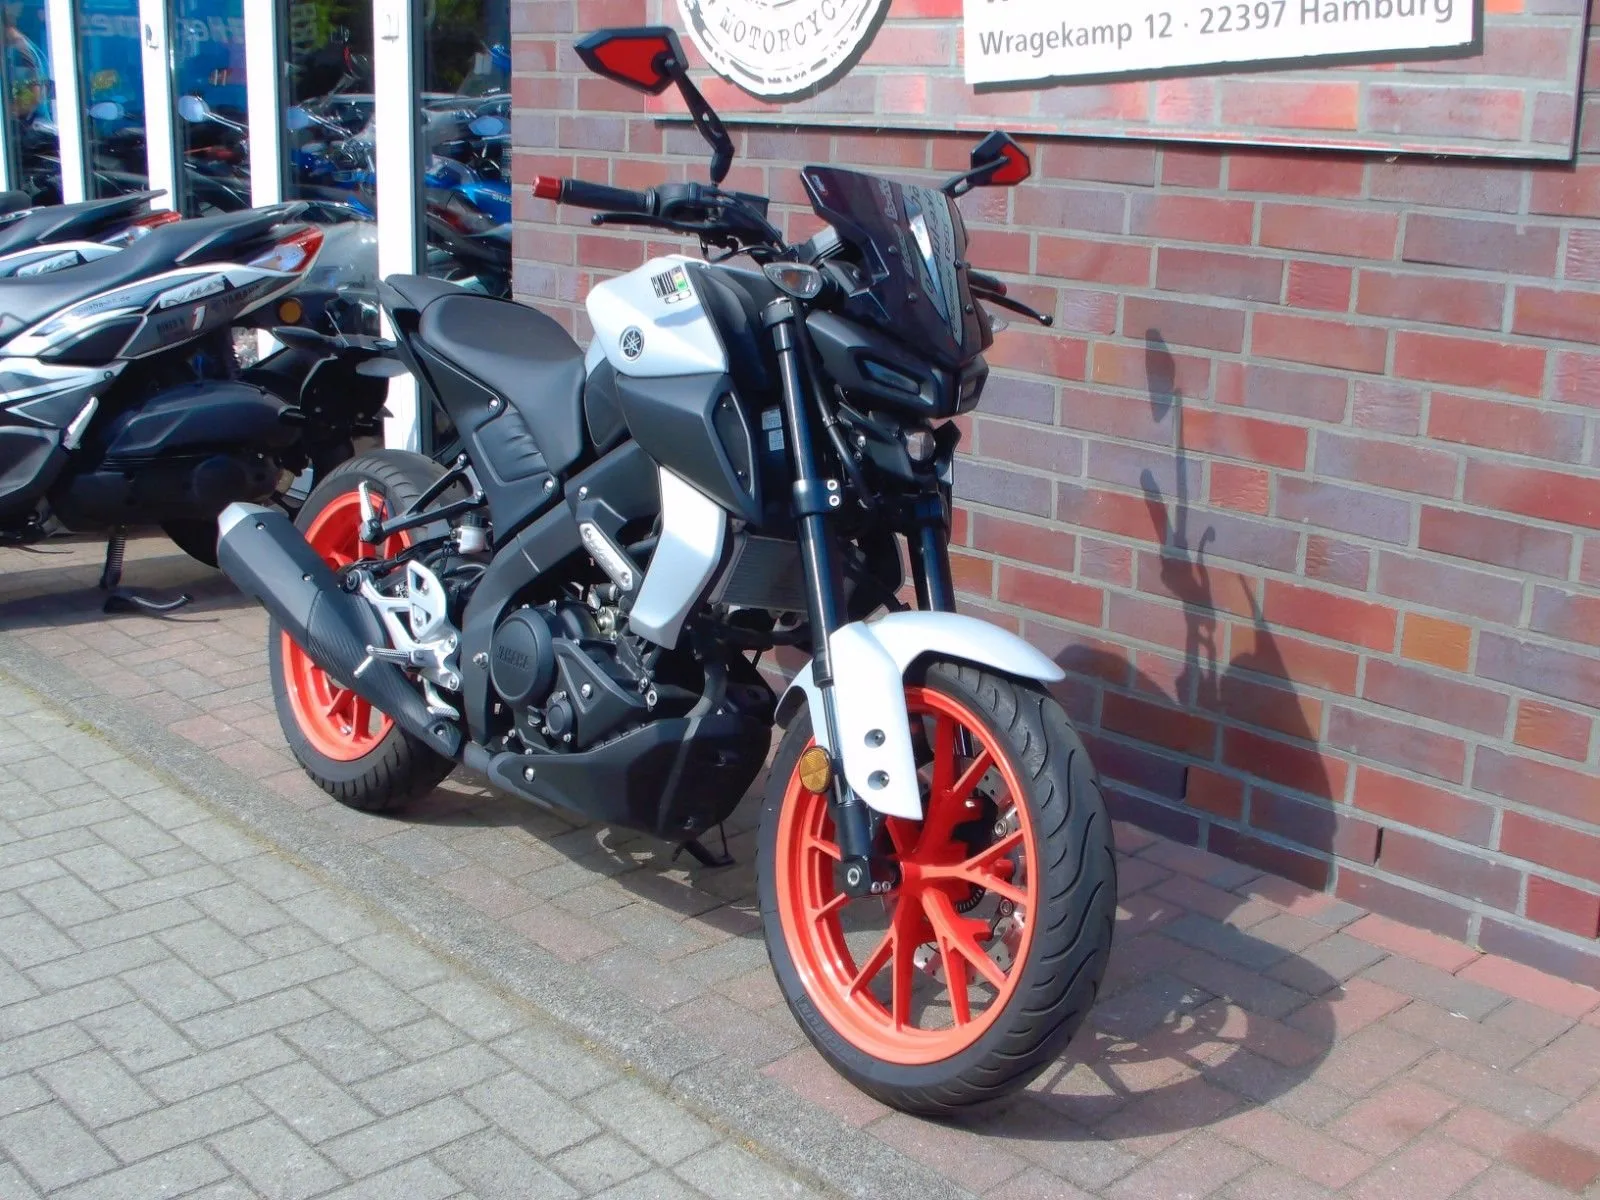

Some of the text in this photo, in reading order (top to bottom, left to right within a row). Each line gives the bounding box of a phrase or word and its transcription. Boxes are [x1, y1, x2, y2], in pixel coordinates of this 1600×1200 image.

[719, 0, 847, 54] MOTORCYC
[979, 22, 1132, 58] Wragekamp
[1145, 12, 1172, 39] 12
[1200, 0, 1286, 34] 22397
[1301, 0, 1453, 25] Hamburg
